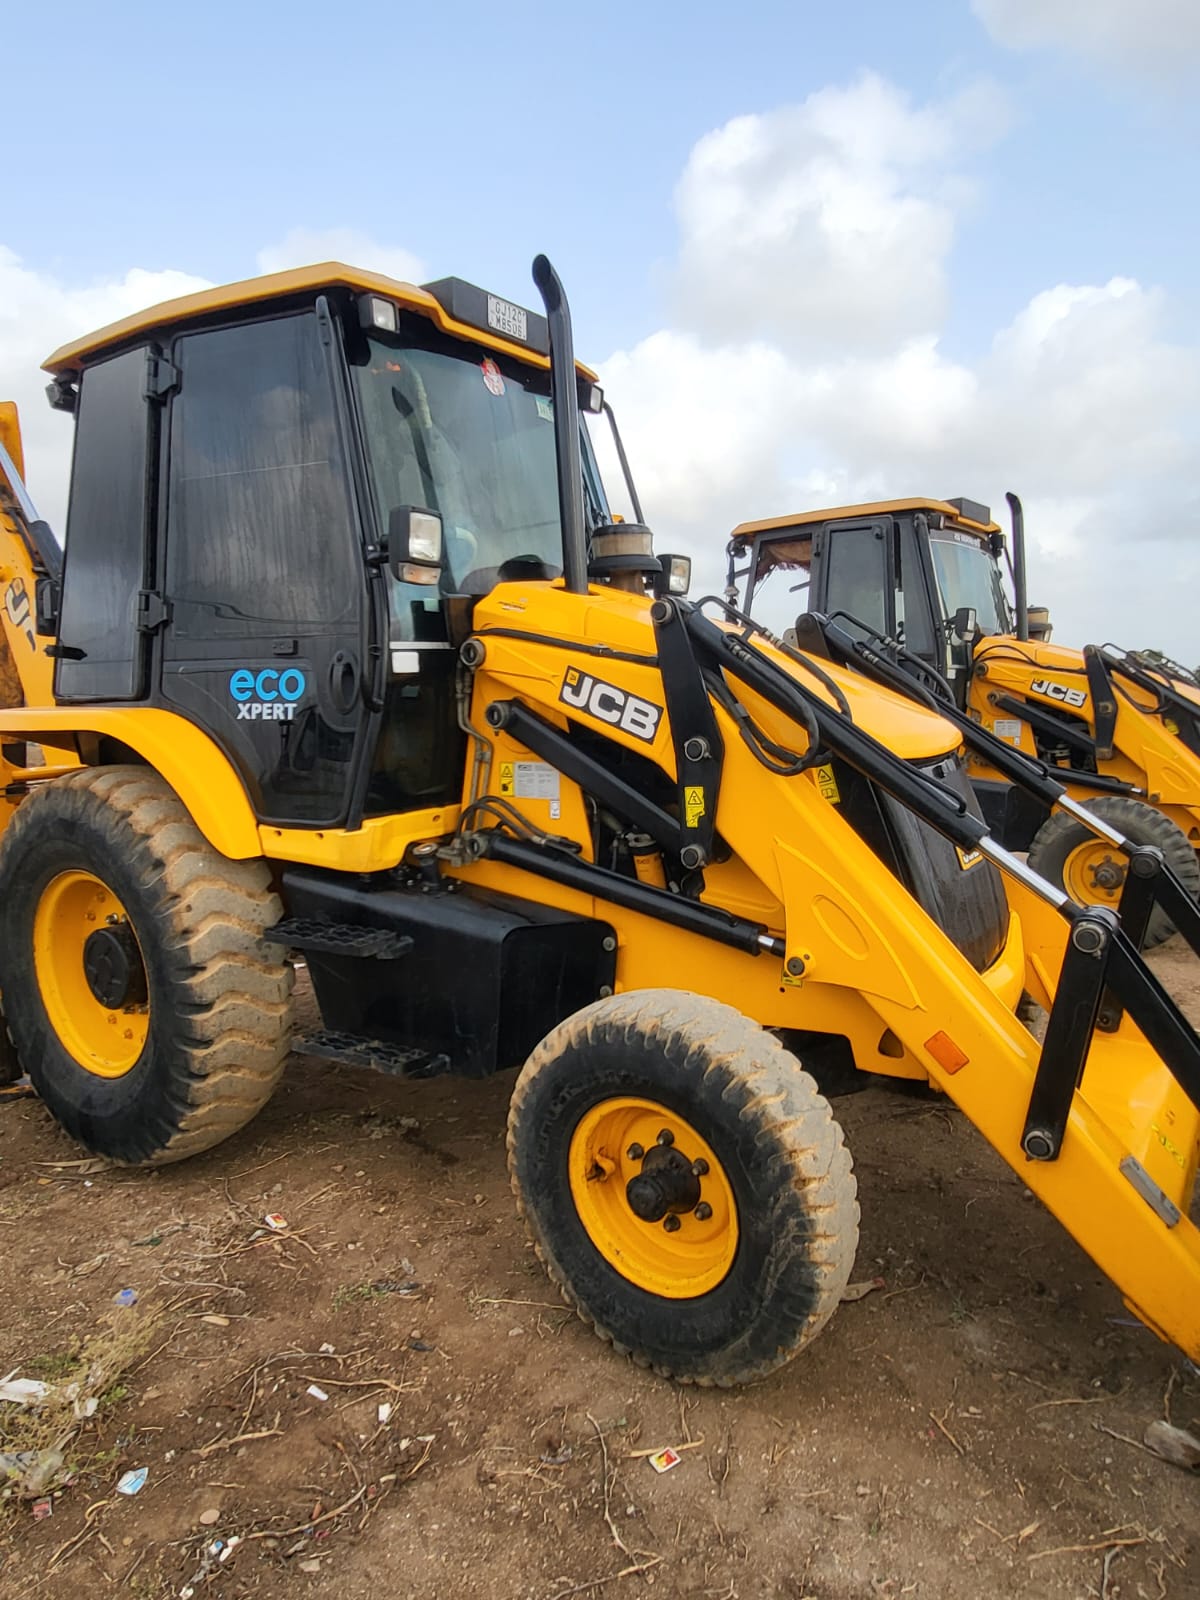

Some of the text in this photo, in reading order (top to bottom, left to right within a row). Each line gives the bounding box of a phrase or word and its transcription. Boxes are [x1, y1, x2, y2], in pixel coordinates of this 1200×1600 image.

[230, 668, 306, 701] eco
[1031, 680, 1086, 707] JCB
[236, 703, 298, 720] XPERT
[562, 676, 659, 739] JCB
